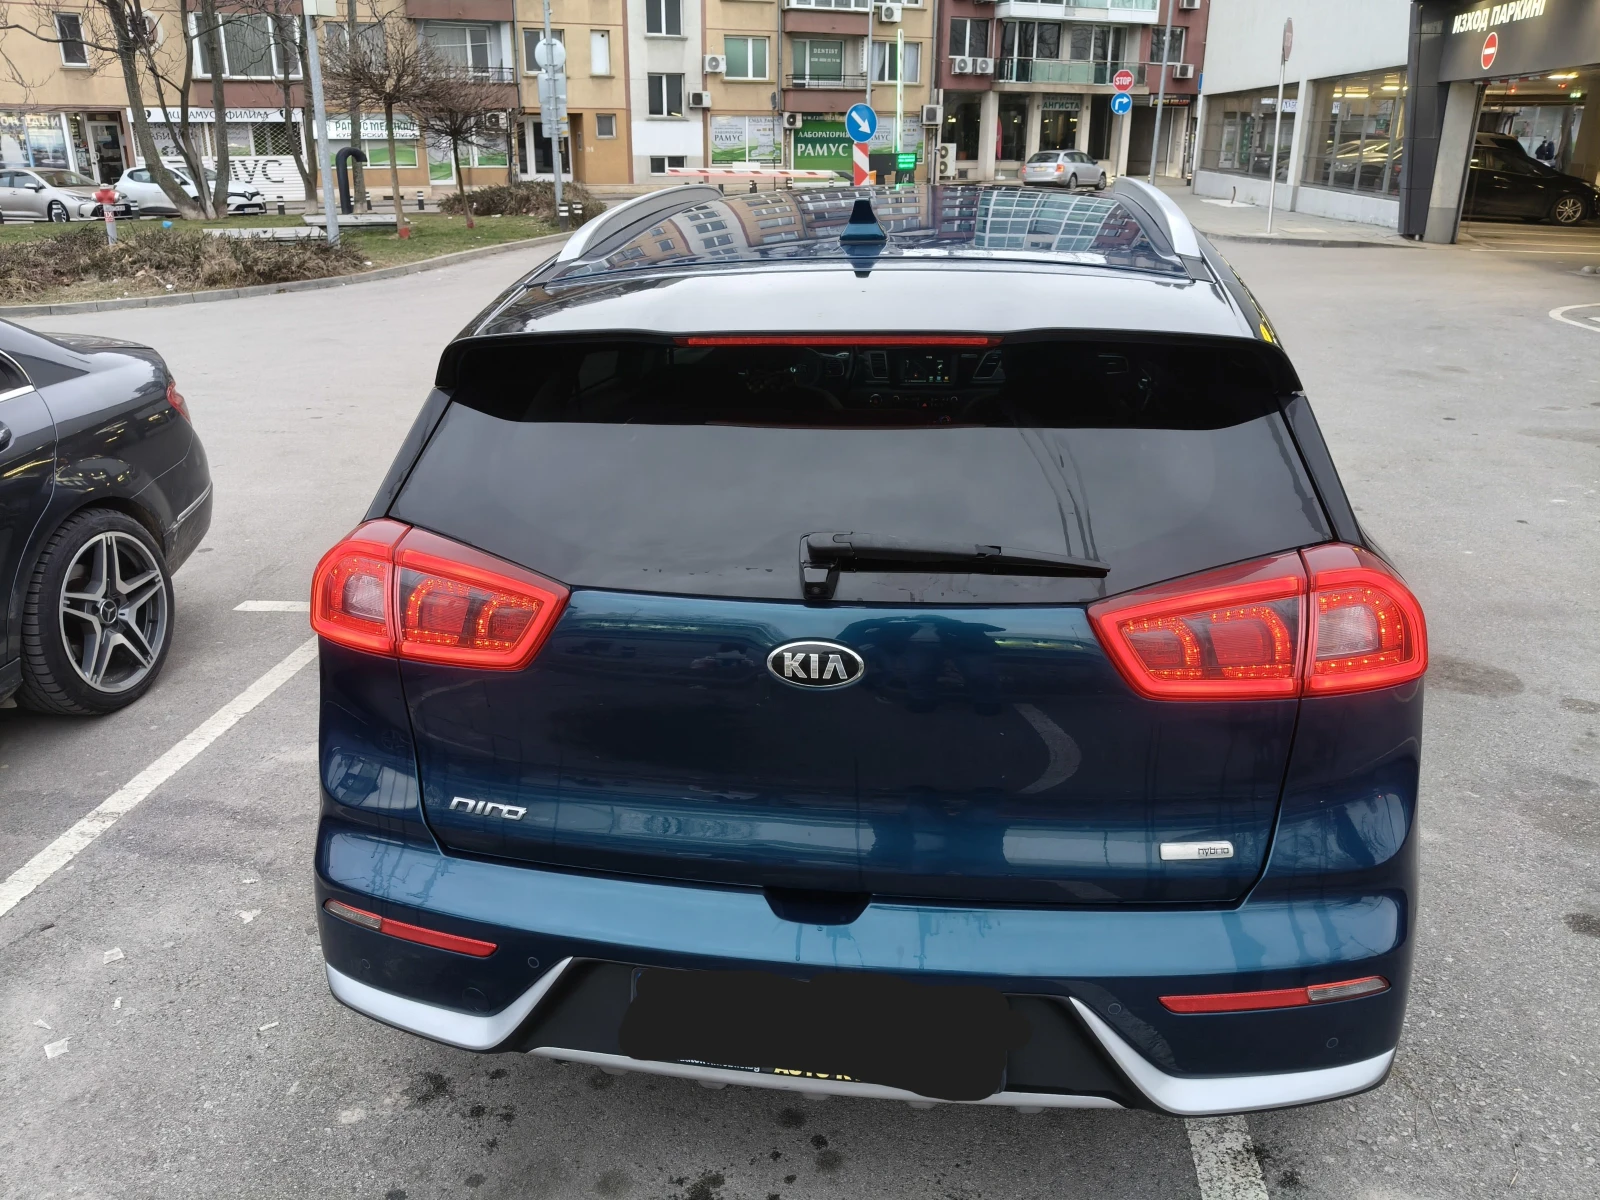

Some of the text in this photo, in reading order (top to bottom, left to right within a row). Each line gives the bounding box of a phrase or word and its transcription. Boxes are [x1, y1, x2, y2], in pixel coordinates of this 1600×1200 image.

[1452, 8, 1490, 34] ИЗХОД
[1115, 76, 1132, 86] STOP
[1042, 101, 1080, 110] АНГИСТА
[189, 111, 216, 119] АМУС
[224, 111, 268, 120] ФИЛИАЛ
[797, 143, 849, 158] РАМУС
[783, 652, 848, 680] KIA
[449, 796, 528, 821] niro
[1198, 847, 1230, 857] hybrid
